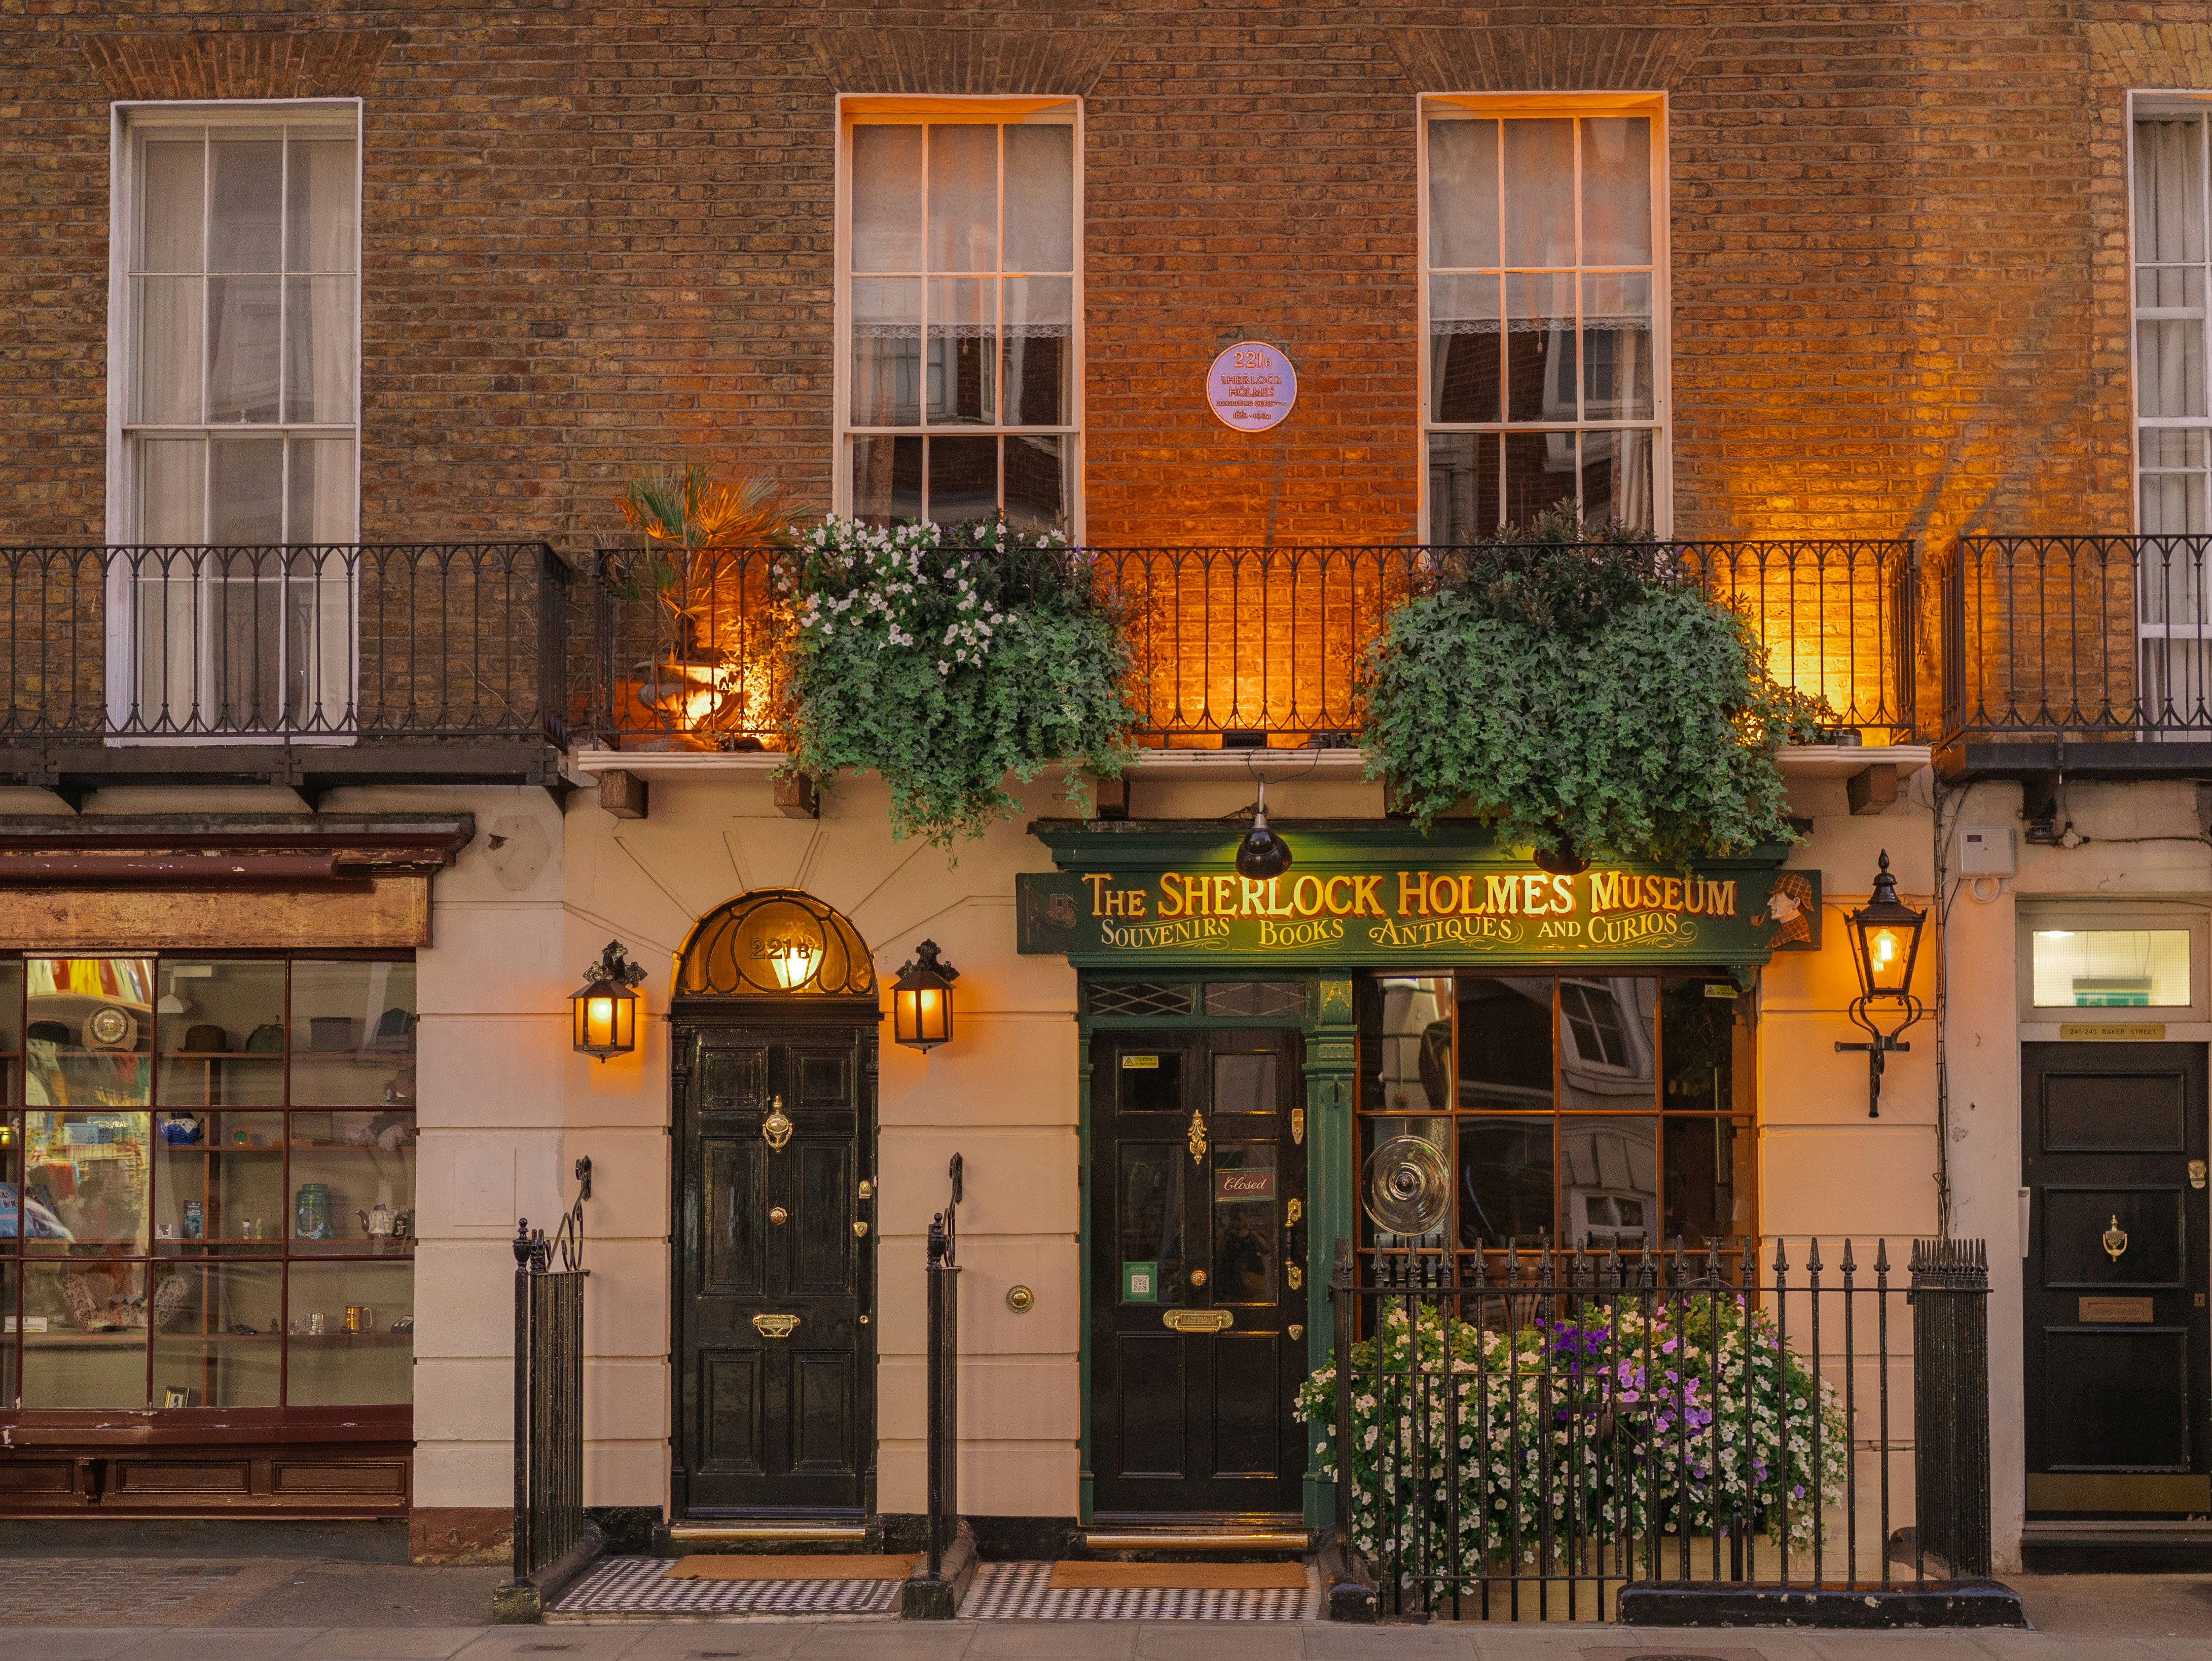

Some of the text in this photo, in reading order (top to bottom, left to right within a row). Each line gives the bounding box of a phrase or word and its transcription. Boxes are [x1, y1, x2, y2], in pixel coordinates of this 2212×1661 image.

[1234, 351, 1272, 368] 221b
[1221, 374, 1282, 384] SHERLOCK
[1229, 387, 1275, 396] HOLMES
[1233, 411, 1248, 419] 1881
[1082, 871, 1735, 919] THE SHERLOCK HOLMES MUSEUM
[1101, 913, 1679, 948] SOUVENIRS BOOKS ANTIQUES AND CURIOS
[750, 938, 810, 959] 221B
[1224, 1176, 1267, 1190] Closed
